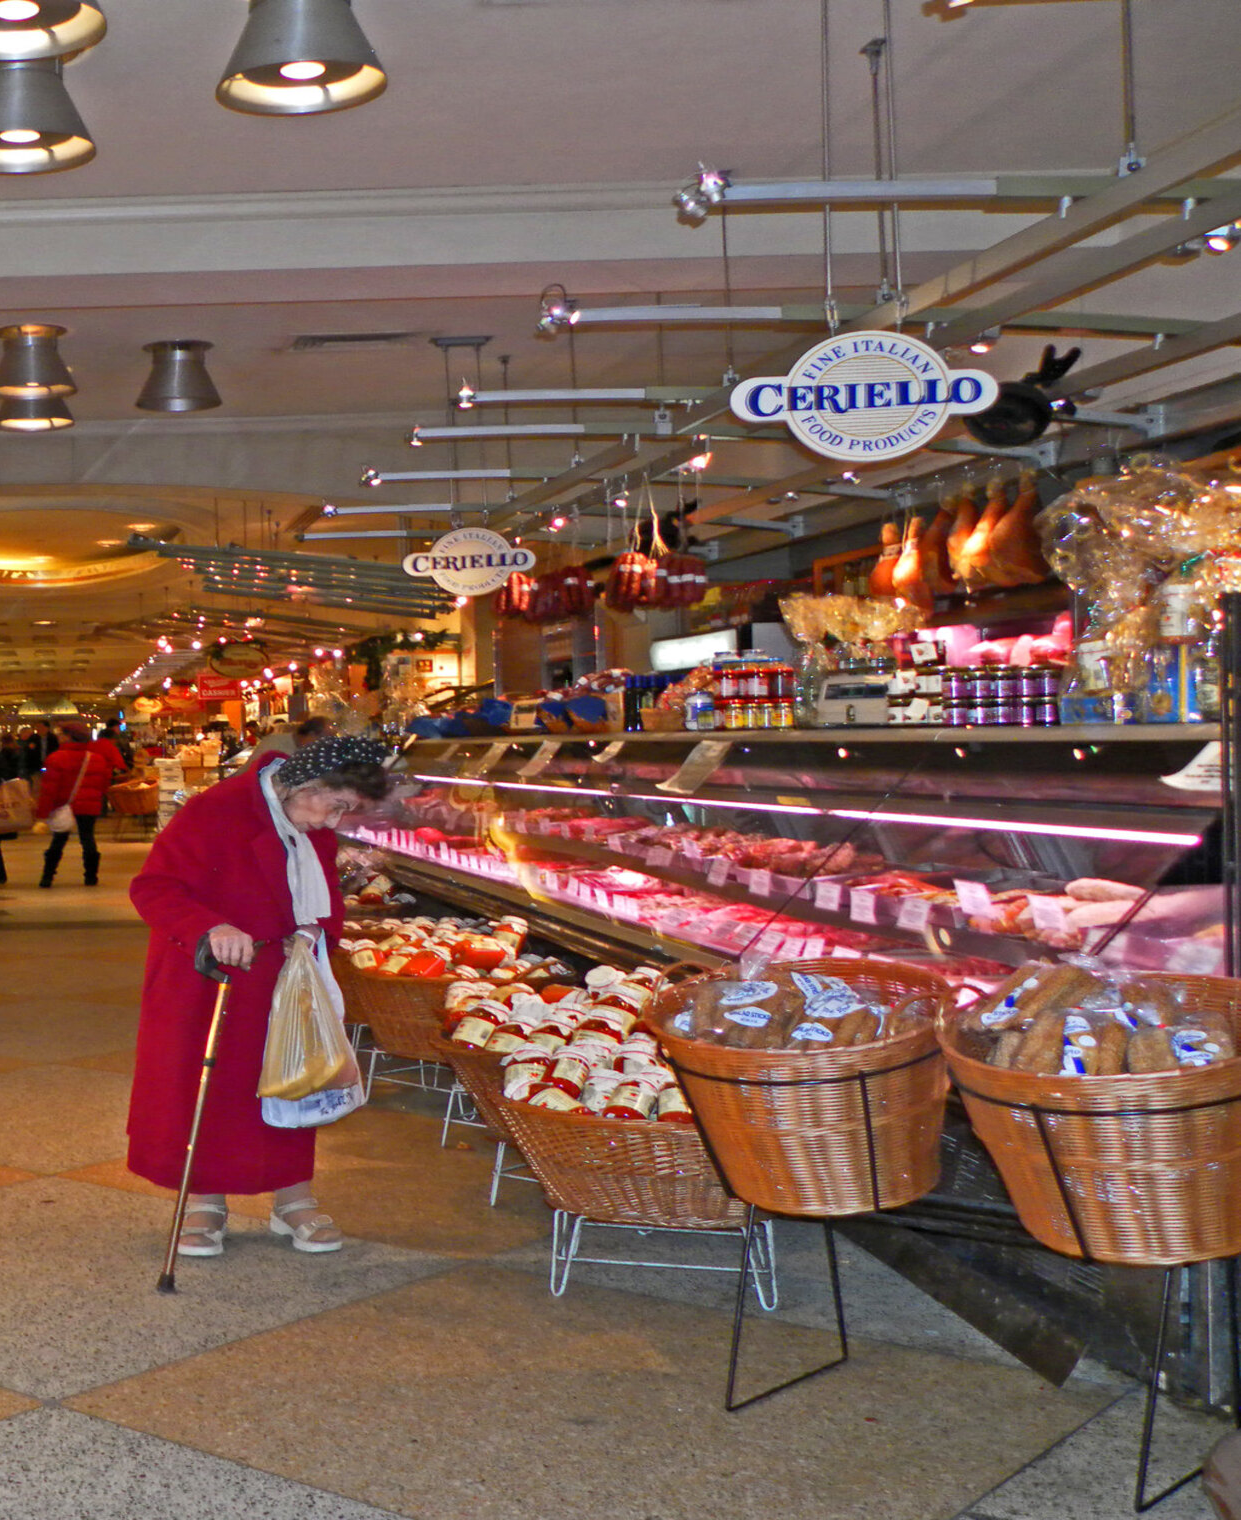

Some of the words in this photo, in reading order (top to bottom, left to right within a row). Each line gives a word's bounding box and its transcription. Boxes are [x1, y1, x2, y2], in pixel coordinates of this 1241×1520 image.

[802, 345, 846, 380] FINE
[853, 340, 934, 374] ITALIAN
[745, 376, 983, 417] CERIELLO
[800, 414, 843, 447] FOOD
[848, 409, 938, 451] PRODUCTS
[412, 552, 528, 573] CERIELLO
